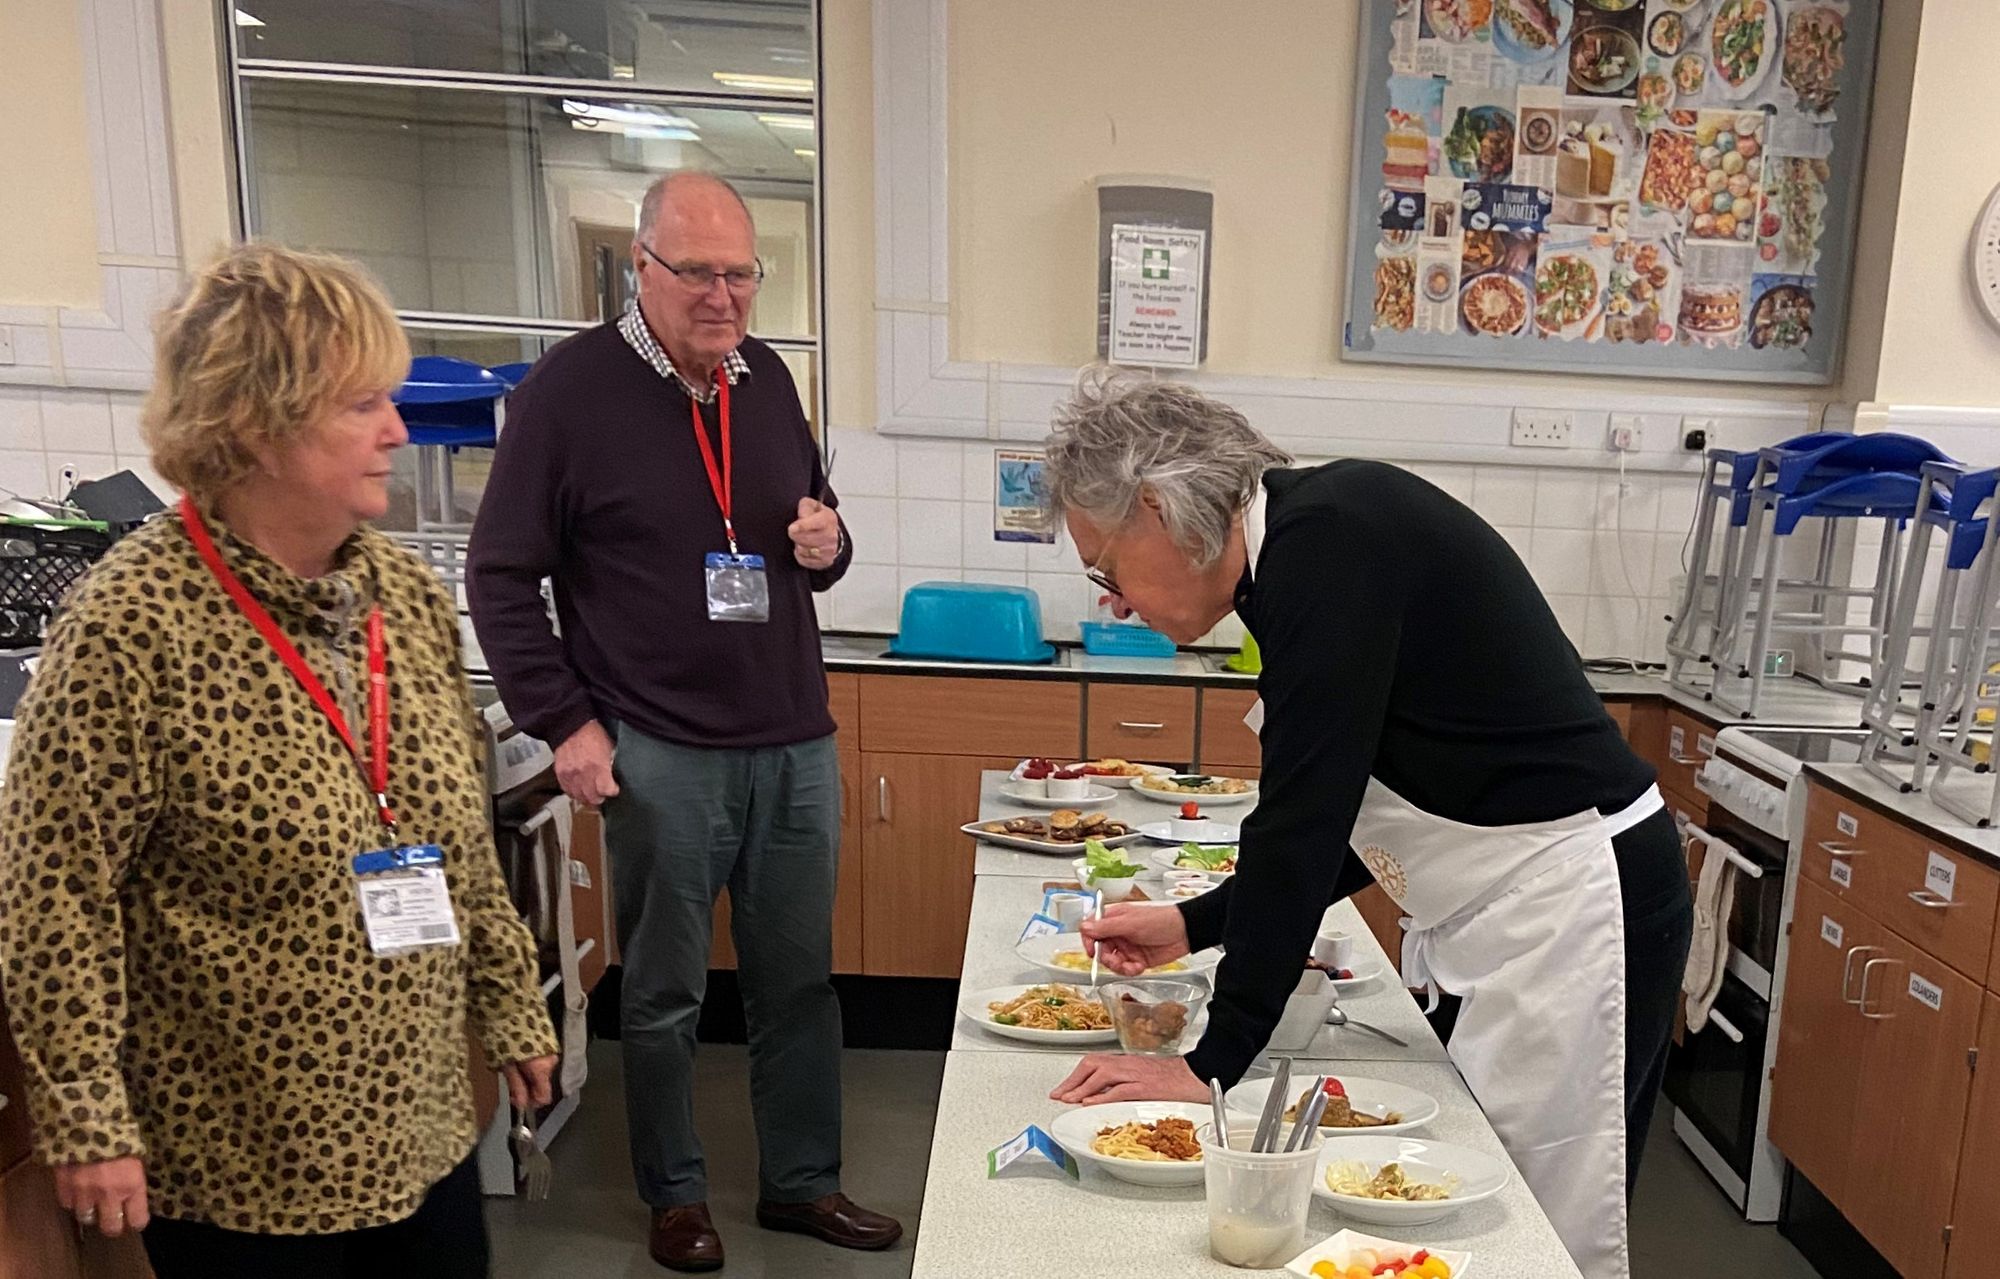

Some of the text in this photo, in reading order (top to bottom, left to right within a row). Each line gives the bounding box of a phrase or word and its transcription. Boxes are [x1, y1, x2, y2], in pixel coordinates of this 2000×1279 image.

[1492, 203, 1539, 221] MUMMIES
[1119, 234, 1140, 244] Food
[1169, 238, 1199, 249] Safety
[1159, 284, 1187, 293] yourself
[1129, 321, 1152, 330] Always
[1118, 330, 1144, 338] Teacher
[1929, 865, 1951, 884] CUTTERS
[1911, 979, 1939, 1006] COLANDERS
